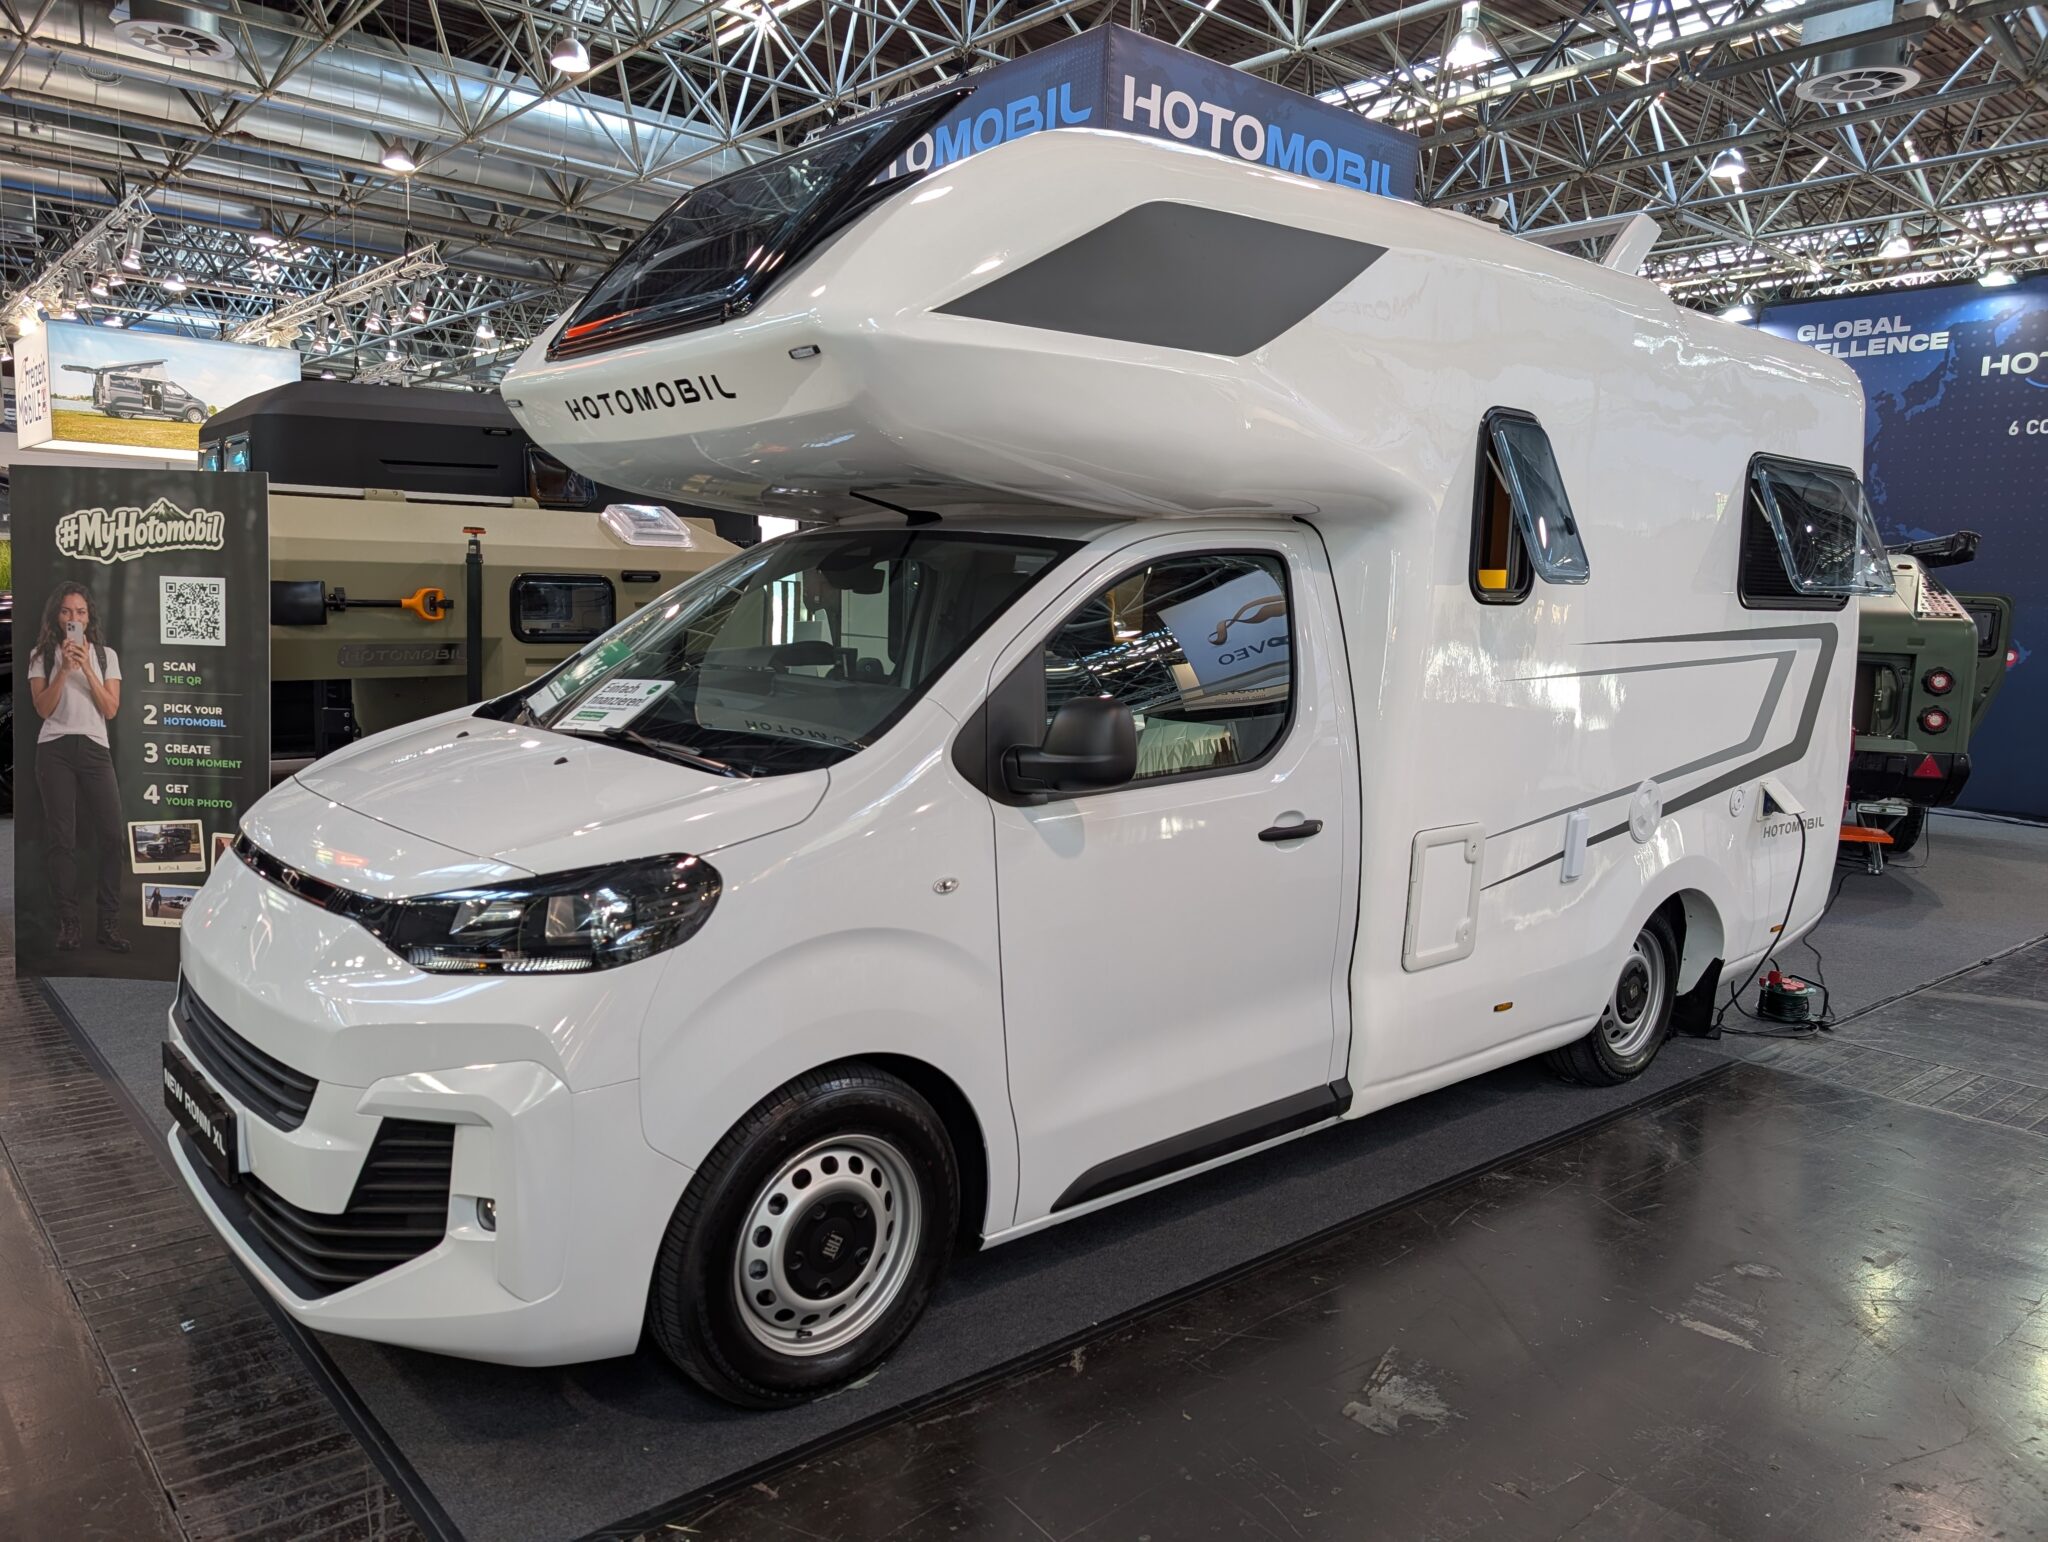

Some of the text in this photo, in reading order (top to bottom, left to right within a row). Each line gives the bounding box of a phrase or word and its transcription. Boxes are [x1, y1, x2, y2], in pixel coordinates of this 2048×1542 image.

[1797, 315, 1911, 341] GLOBAL
[565, 375, 736, 421] HOTOMOBIL
[2009, 421, 2019, 435] 6
[60, 510, 221, 558] #MyHotomobil
[144, 662, 196, 683] 1 SCAN
[163, 675, 202, 686] THE QR
[602, 682, 642, 693] Einfach
[143, 703, 223, 725] 2 PICK YOUR
[163, 717, 227, 728] HOTOMOBIL
[144, 742, 211, 763] 3 CREATE
[165, 757, 242, 769] YOUR MOMENT
[143, 784, 189, 804] 4 GET
[165, 797, 233, 809] YOUR PHOTO
[164, 1068, 226, 1156] NEW RONIN XL
[822, 1233, 843, 1260] FIAT
